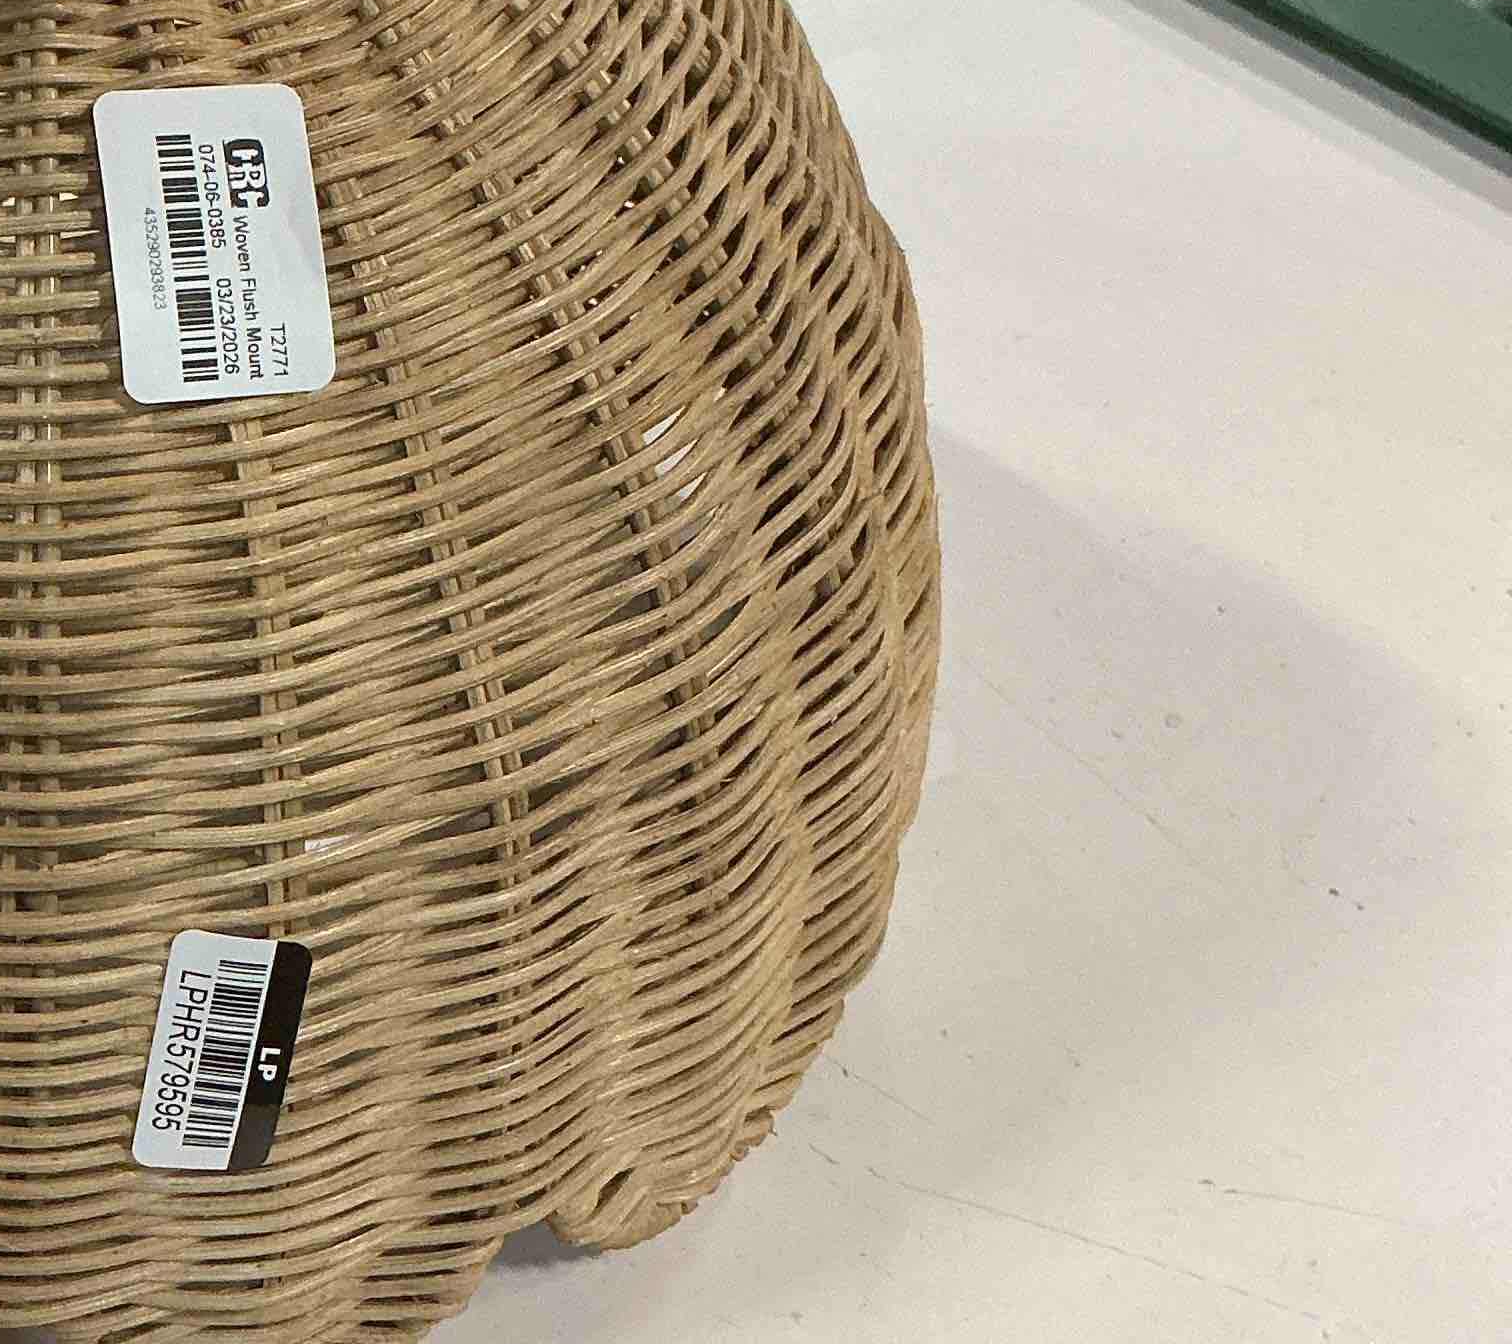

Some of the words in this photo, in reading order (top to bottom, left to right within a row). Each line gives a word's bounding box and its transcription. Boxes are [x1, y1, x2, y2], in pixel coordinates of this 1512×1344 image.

[223, 138, 269, 208] CRC
[198, 145, 226, 248] 074-06-0385
[216, 278, 240, 374] 03/23/2026
[233, 216, 252, 272] Woven
[243, 278, 262, 321] Flush
[246, 328, 264, 380] Mount
[269, 324, 288, 378] T2771
[152, 969, 212, 1131] LPHR579595
[257, 1046, 281, 1082] LP
